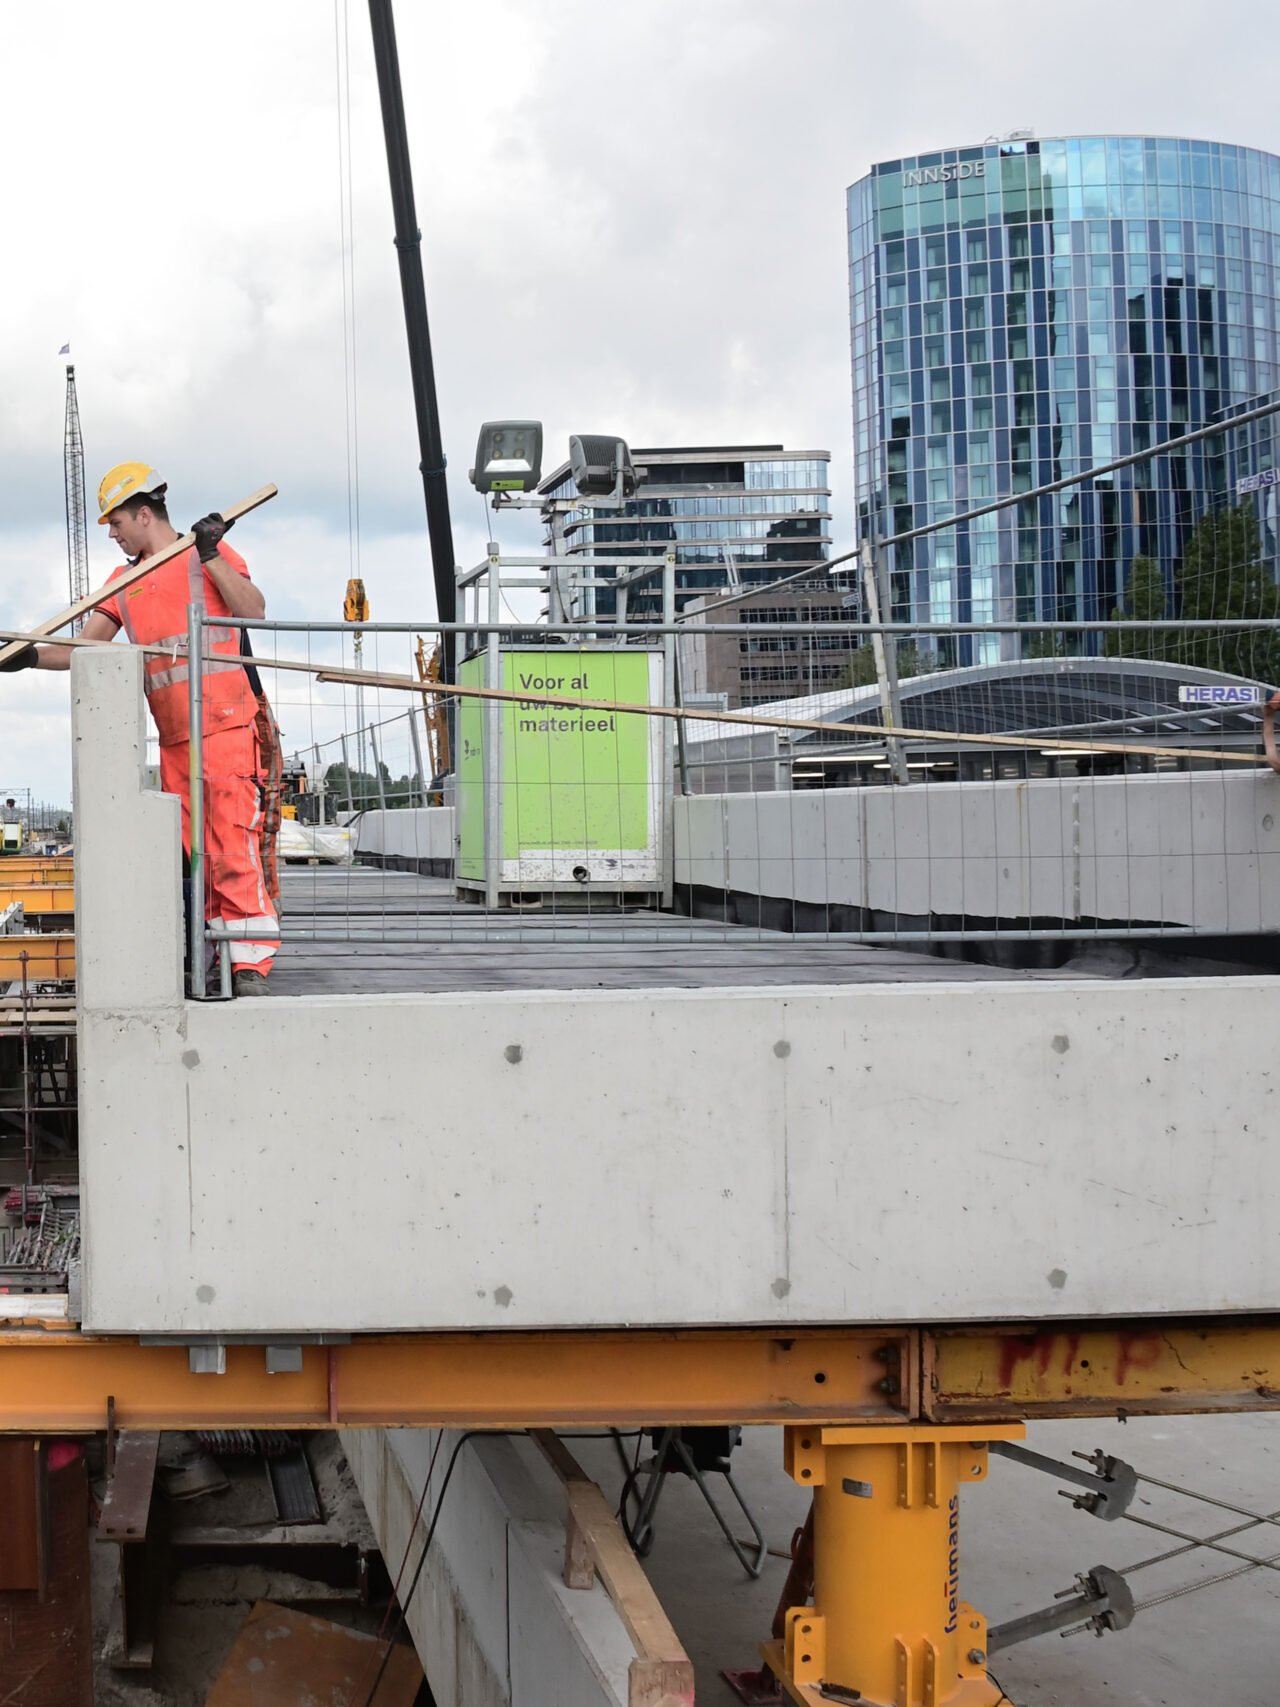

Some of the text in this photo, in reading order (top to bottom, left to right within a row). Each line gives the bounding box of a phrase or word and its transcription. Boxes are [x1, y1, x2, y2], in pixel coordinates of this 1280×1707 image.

[1239, 470, 1274, 491] HEAS
[519, 672, 589, 690] Voor al
[519, 715, 616, 732] materieel
